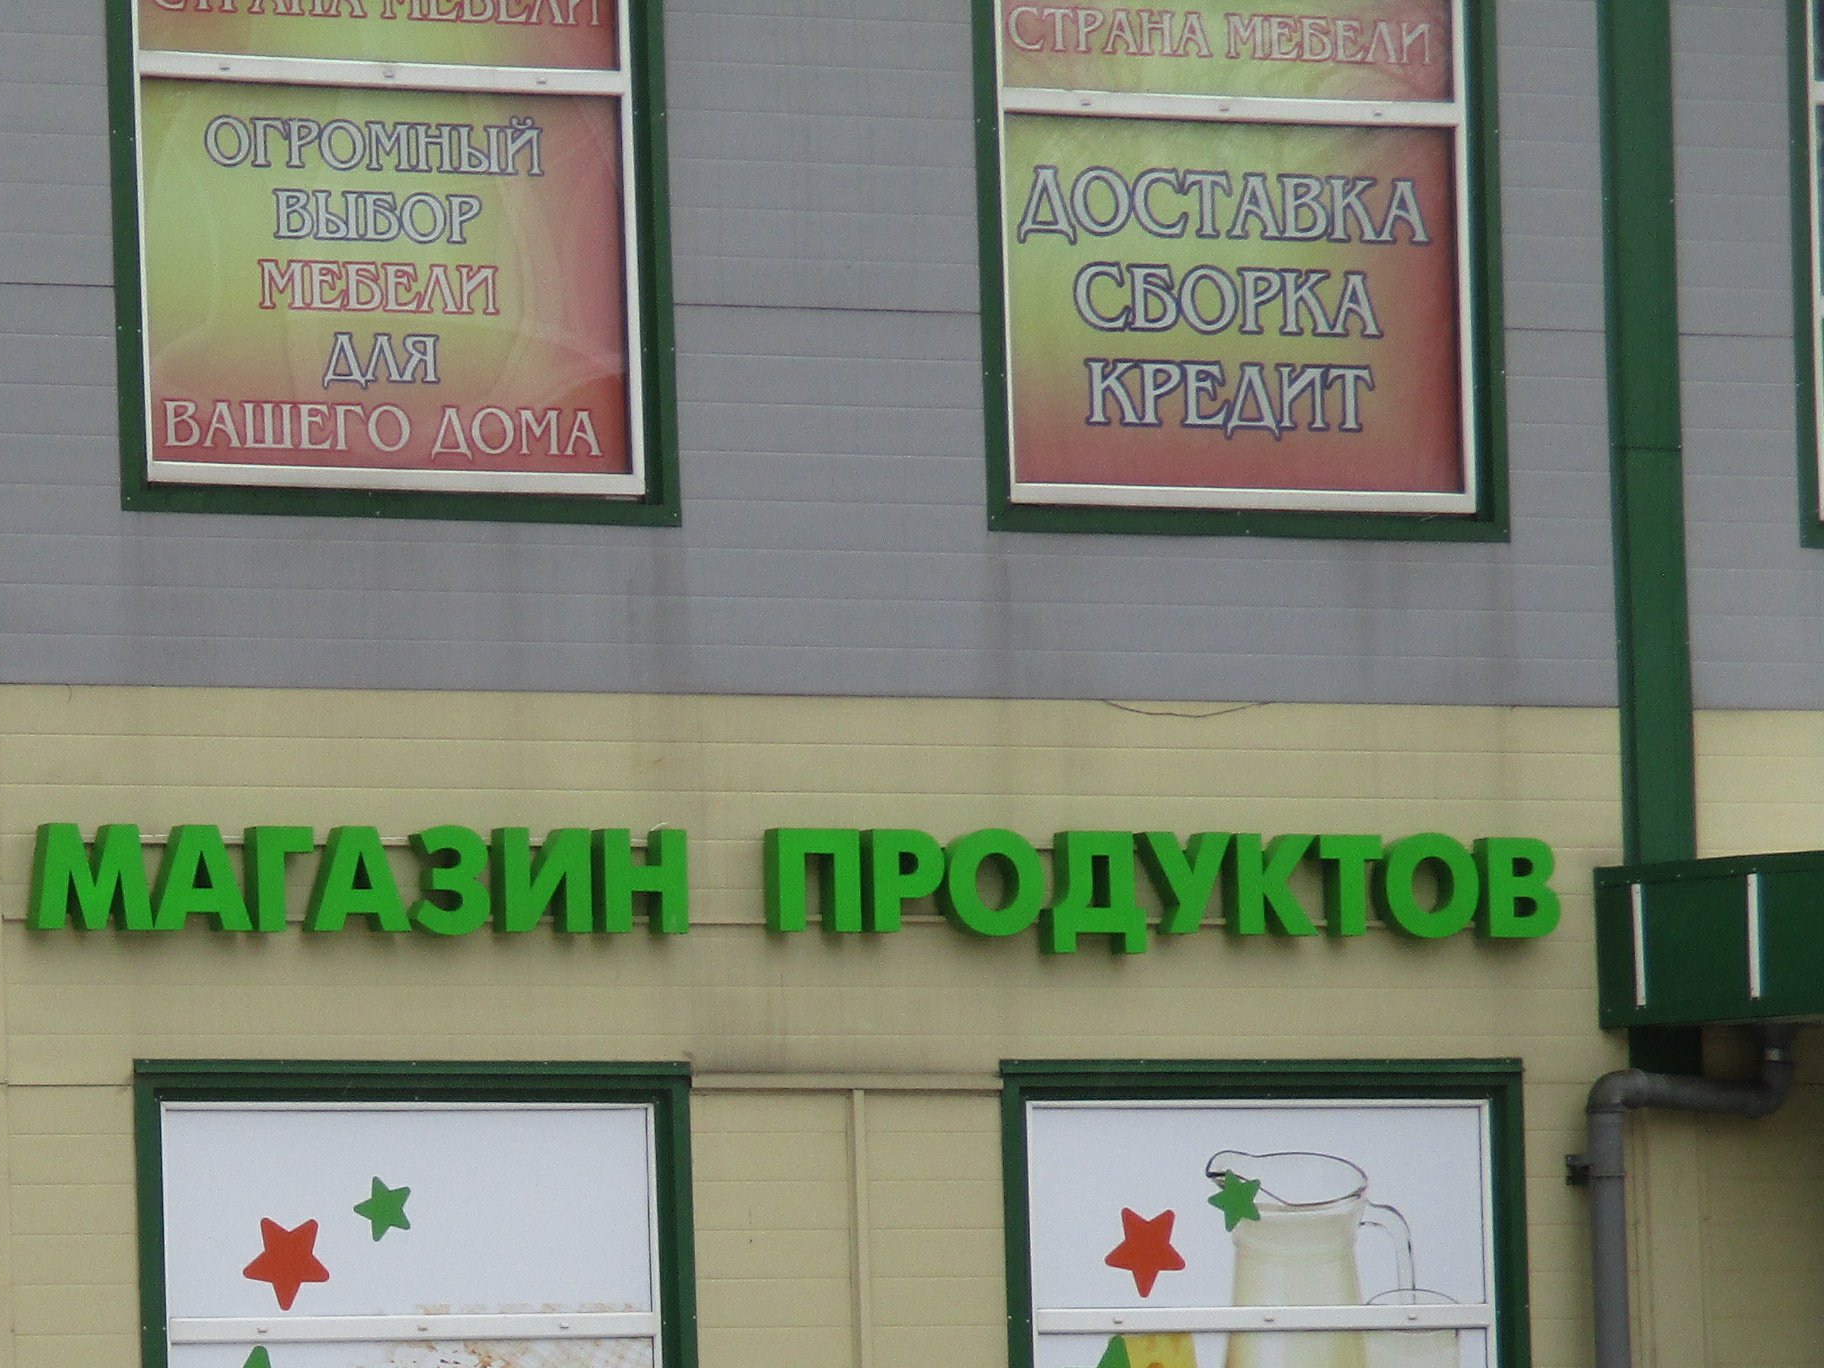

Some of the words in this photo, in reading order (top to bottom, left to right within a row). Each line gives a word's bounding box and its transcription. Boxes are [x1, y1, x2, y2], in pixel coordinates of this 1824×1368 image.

[1006, 4, 1213, 58] СТРАНА
[1225, 14, 1433, 65] МЕБЕЛИ
[204, 115, 544, 176] ОГРОМНЫЙ
[272, 188, 482, 244] ВЫБОР
[1017, 164, 1431, 244] ДОСТАВКА
[257, 259, 500, 315] МЕБЕЛИ
[1075, 261, 1382, 337] СБОРКА
[323, 331, 440, 389] ДЛЯ
[162, 398, 412, 454] ВАШЕГО
[430, 405, 604, 460] ДОМА
[1084, 358, 1374, 439] КРЕДИТ
[26, 823, 689, 934] МАГАЗИН
[763, 827, 1562, 954] ПРОДУКТОВ
